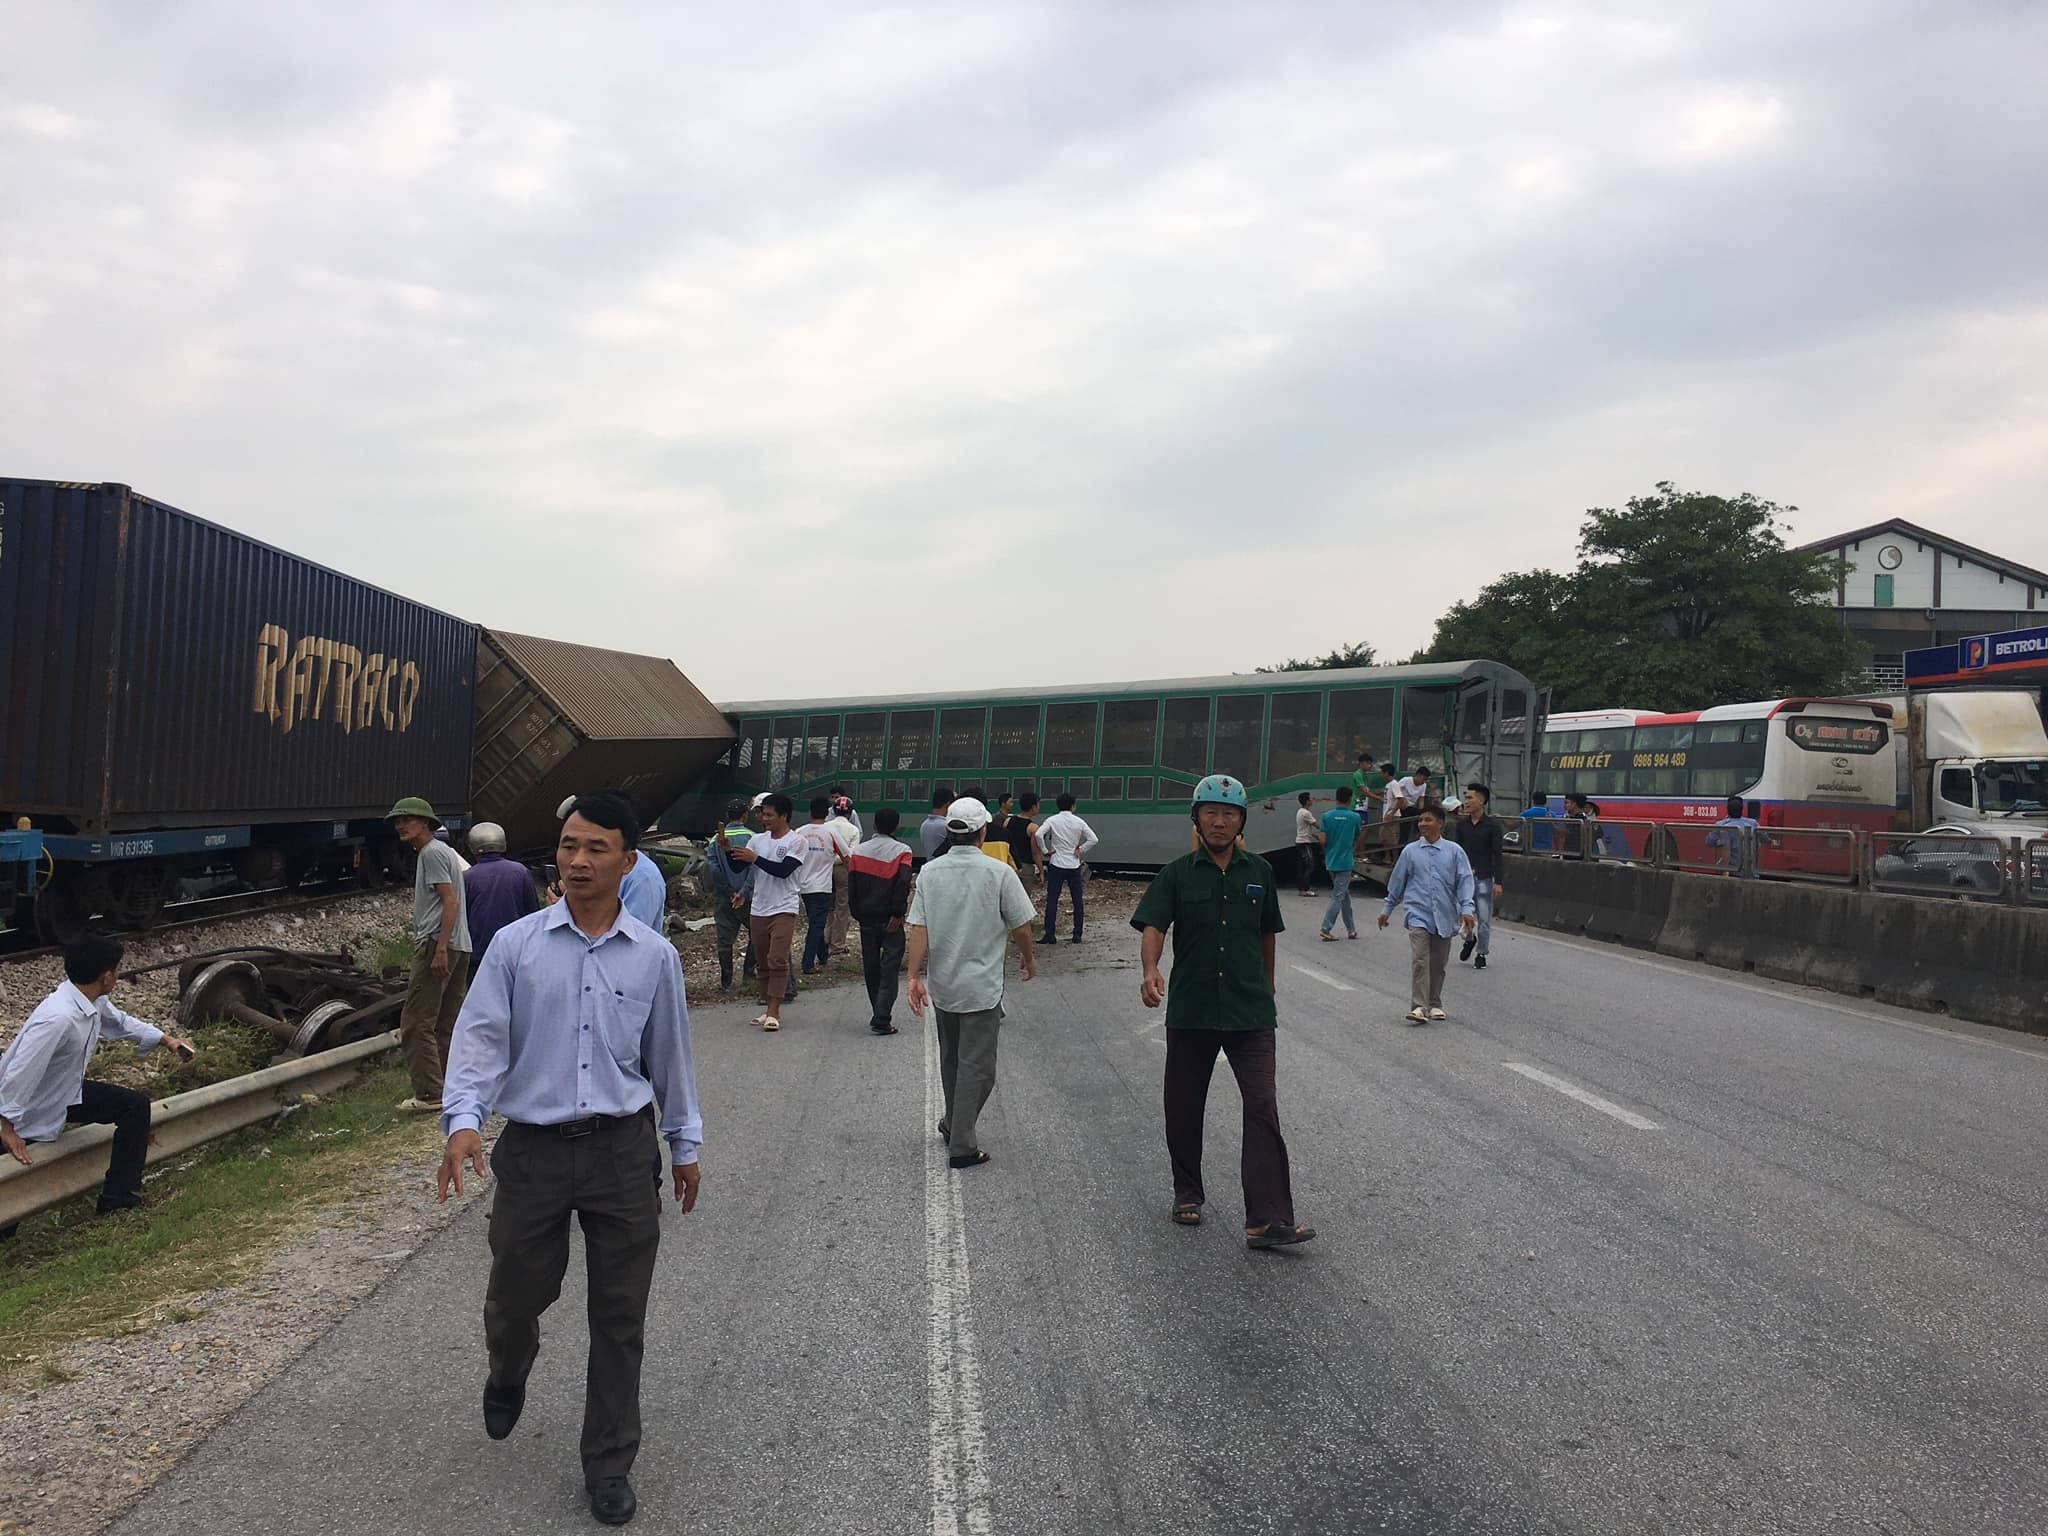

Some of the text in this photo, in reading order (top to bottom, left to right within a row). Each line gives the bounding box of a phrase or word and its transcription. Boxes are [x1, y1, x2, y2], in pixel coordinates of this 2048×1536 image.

[254, 622, 420, 736] RATRACO
[1559, 755, 1585, 769] ANH
[1586, 750, 1612, 768] KẾT
[1633, 751, 1686, 768] 0986 964 489
[125, 839, 154, 856] 631395
